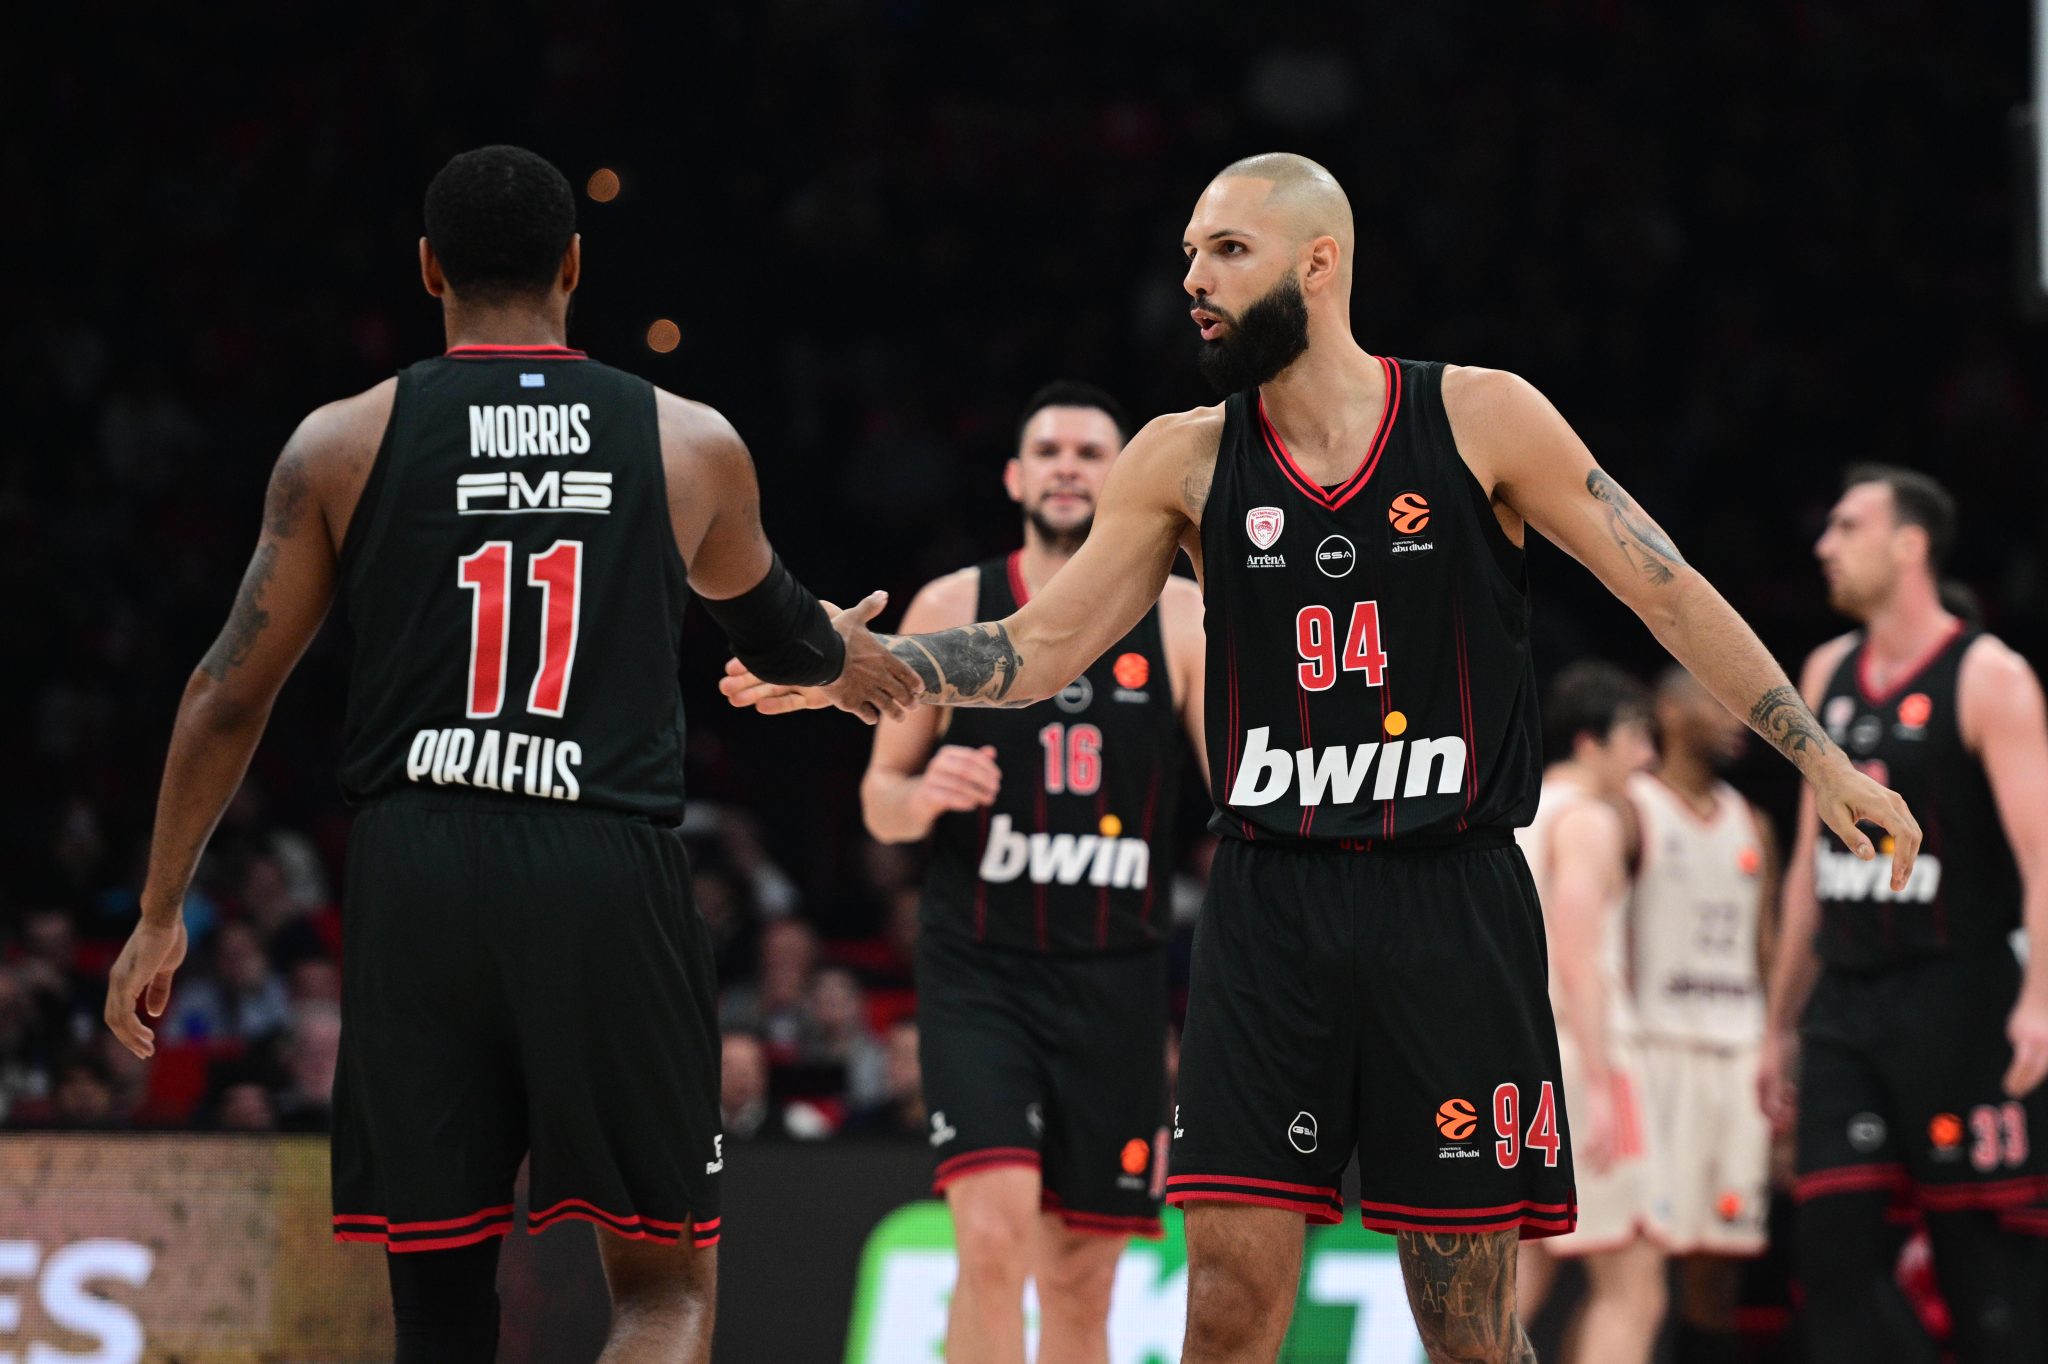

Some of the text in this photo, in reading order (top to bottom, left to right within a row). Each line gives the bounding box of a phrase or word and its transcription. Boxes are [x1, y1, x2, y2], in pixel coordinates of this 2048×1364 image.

[469, 403, 591, 458] MORRIS
[456, 471, 613, 512] FMS
[1319, 551, 1352, 560] GSA
[1392, 542, 1433, 553] abu dhabi
[457, 539, 584, 720] 11
[1296, 600, 1388, 692] 94
[1039, 722, 1102, 795] 16
[1229, 711, 1467, 806] bwin
[979, 813, 1150, 890] bwin
[1439, 1149, 1479, 1159] abu dhabi
[1492, 1081, 1561, 1170] 94
[1968, 1101, 2029, 1173] 33
